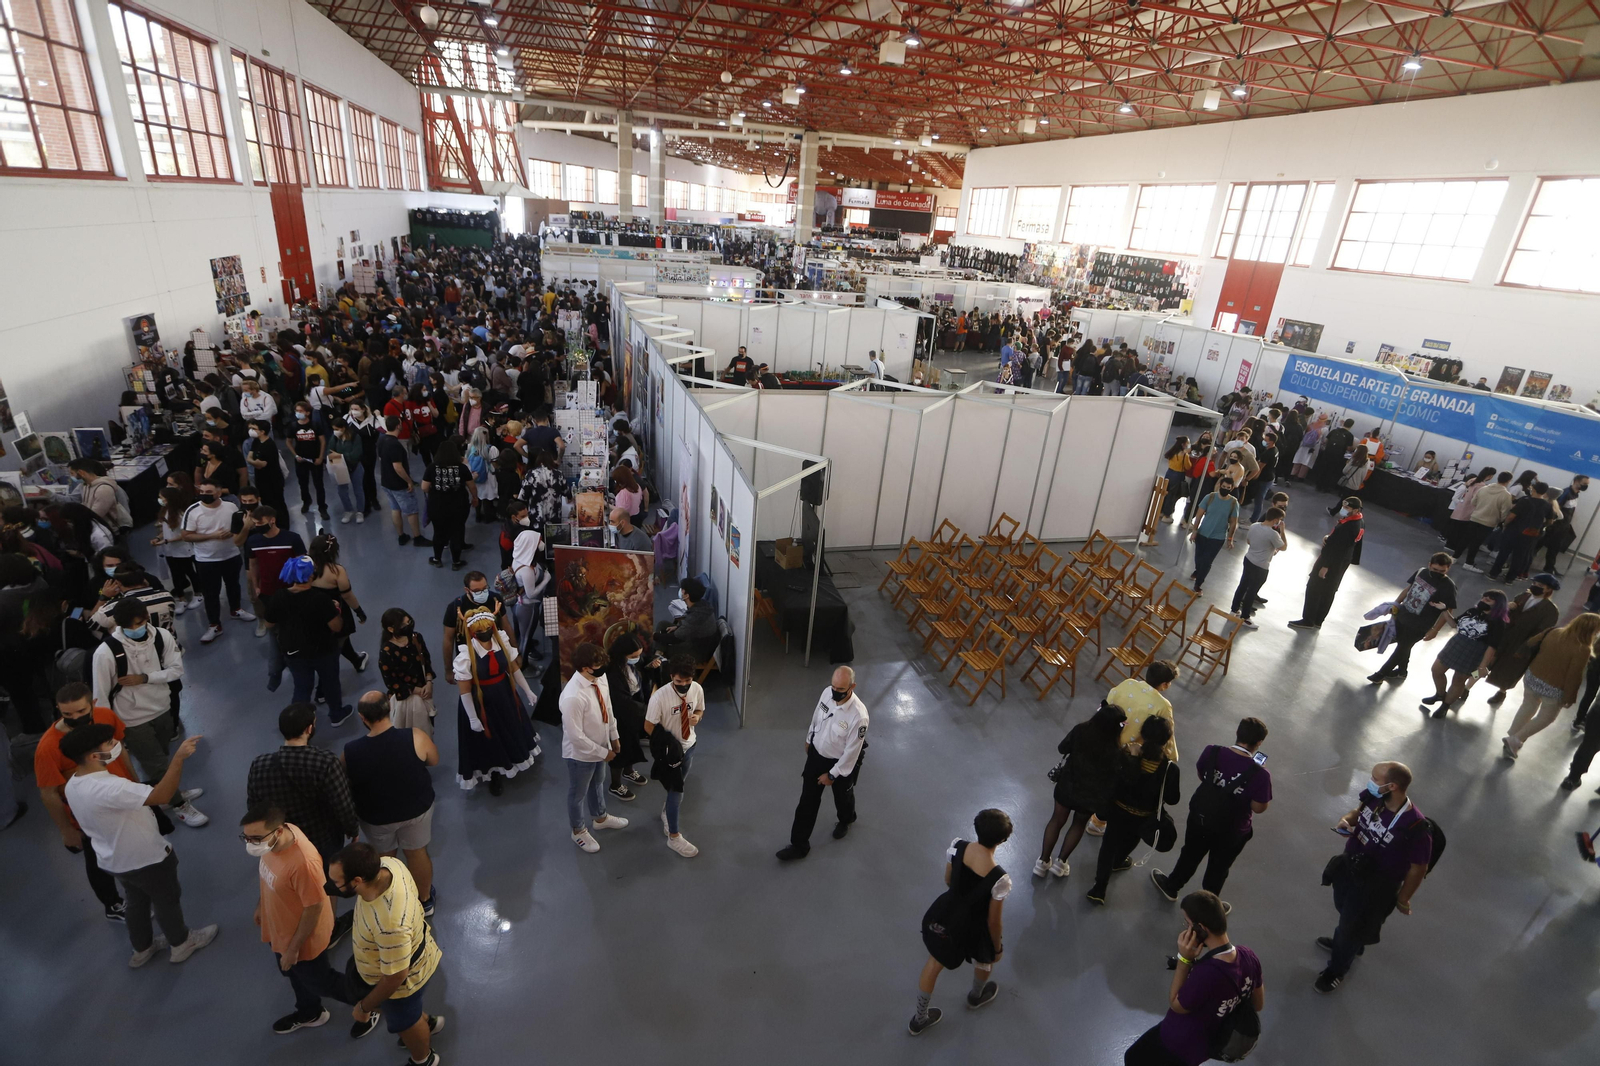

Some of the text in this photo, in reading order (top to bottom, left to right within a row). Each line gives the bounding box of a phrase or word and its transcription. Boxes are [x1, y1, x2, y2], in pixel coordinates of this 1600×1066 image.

[876, 198, 891, 206] Luna
[903, 200, 930, 209] Granada
[1016, 219, 1050, 234] Fermasa
[1290, 373, 1441, 423] CICLO SUPERIOR DE CÓMIC
[1294, 360, 1476, 416] ESCUELA DE ARTE DE GRANADA
